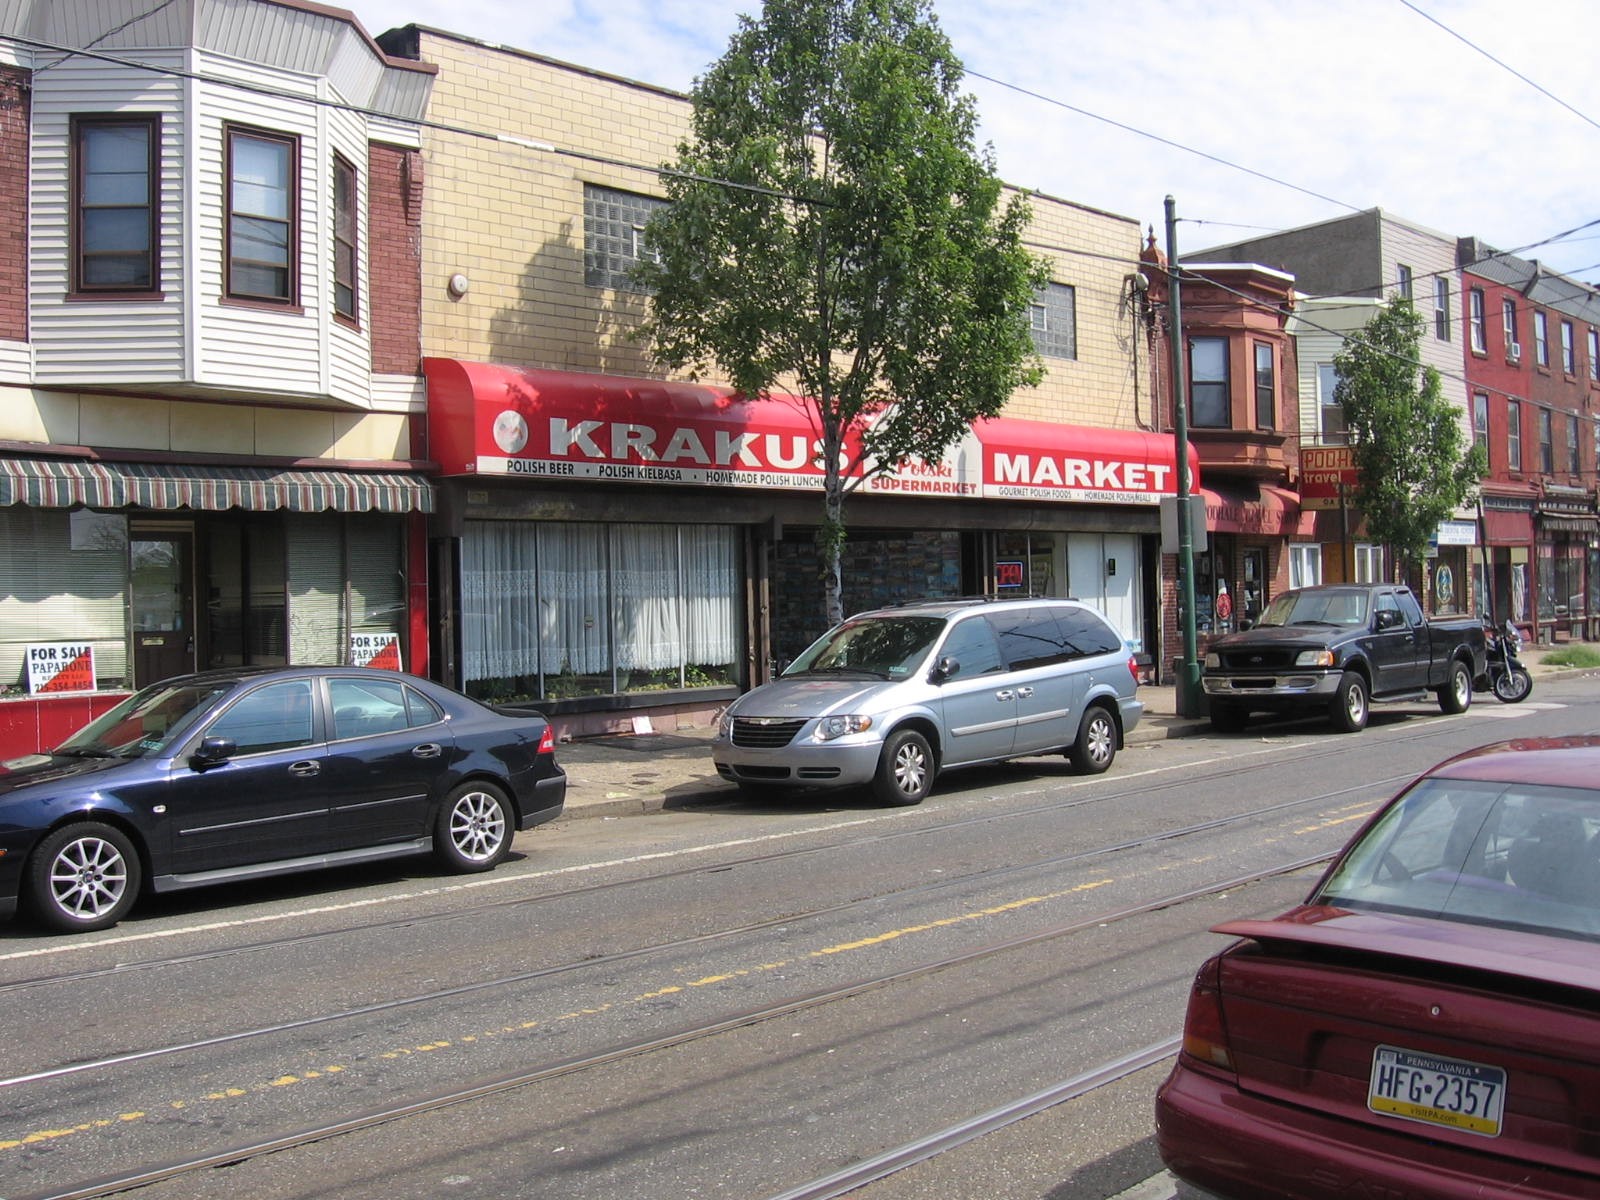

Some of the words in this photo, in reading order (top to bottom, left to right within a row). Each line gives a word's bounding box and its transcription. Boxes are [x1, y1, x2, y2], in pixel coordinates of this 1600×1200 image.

[550, 416, 851, 472] KRAKUS
[507, 459, 546, 474] POLISH
[549, 462, 574, 475] BEER
[599, 465, 635, 479] POLISH
[638, 467, 682, 481] KIELBASA
[994, 452, 1170, 491] MARKET
[706, 471, 758, 485] HOMEMADE
[760, 474, 790, 486] POLISH
[1303, 470, 1342, 484] travel
[871, 478, 977, 494] SUPERMARKET
[999, 486, 1029, 497] GOURMET
[1030, 488, 1051, 498] POLISH
[1052, 489, 1072, 499] FOODS
[1084, 491, 1115, 502] HOMEMADE
[1116, 492, 1135, 503] POLISH
[351, 637, 371, 648] FOR
[374, 637, 396, 647] SALE
[31, 648, 57, 660] FOR
[61, 646, 90, 659] SALE
[32, 660, 91, 674] PAPARONE
[1406, 1056, 1471, 1077] PENNSYLVANIA
